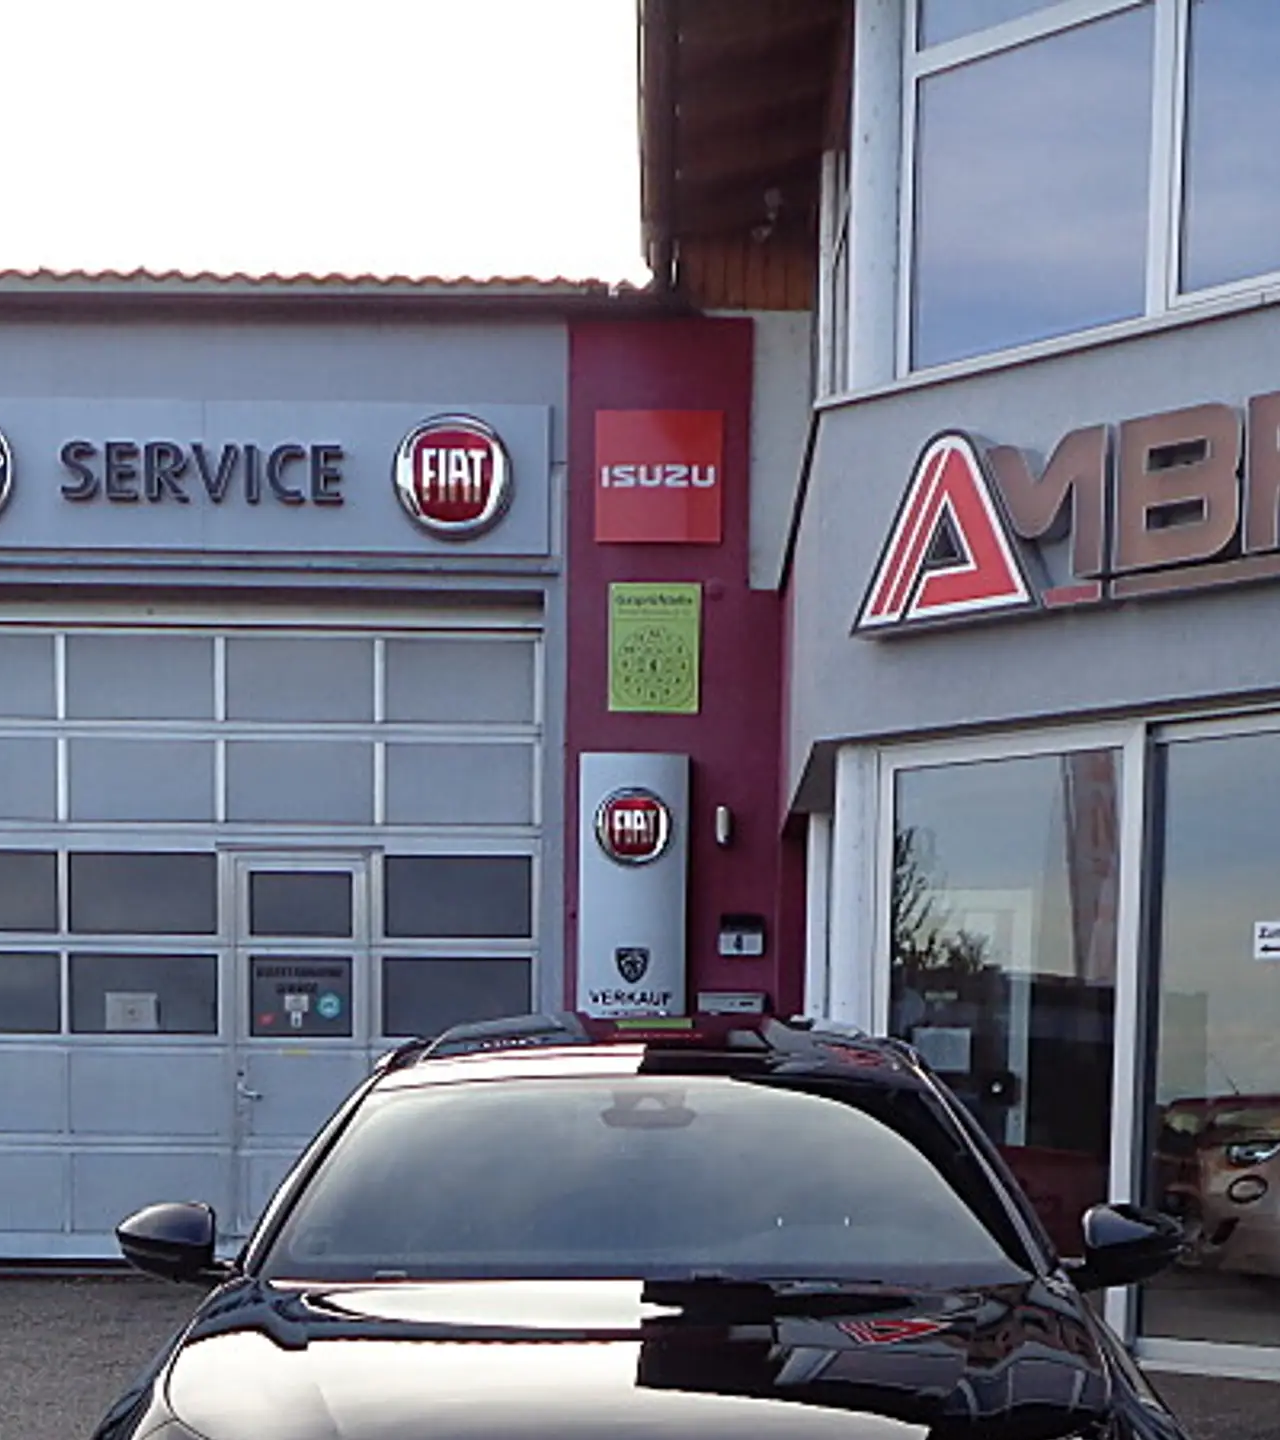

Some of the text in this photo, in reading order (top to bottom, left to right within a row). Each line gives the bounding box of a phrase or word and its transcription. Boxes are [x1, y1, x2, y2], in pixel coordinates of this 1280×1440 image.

[60, 440, 346, 506] SERVICE
[422, 448, 487, 501] FIAT
[601, 466, 716, 488] ISUZU
[613, 810, 658, 845] FIAT
[589, 989, 673, 1006] VERKAUF
